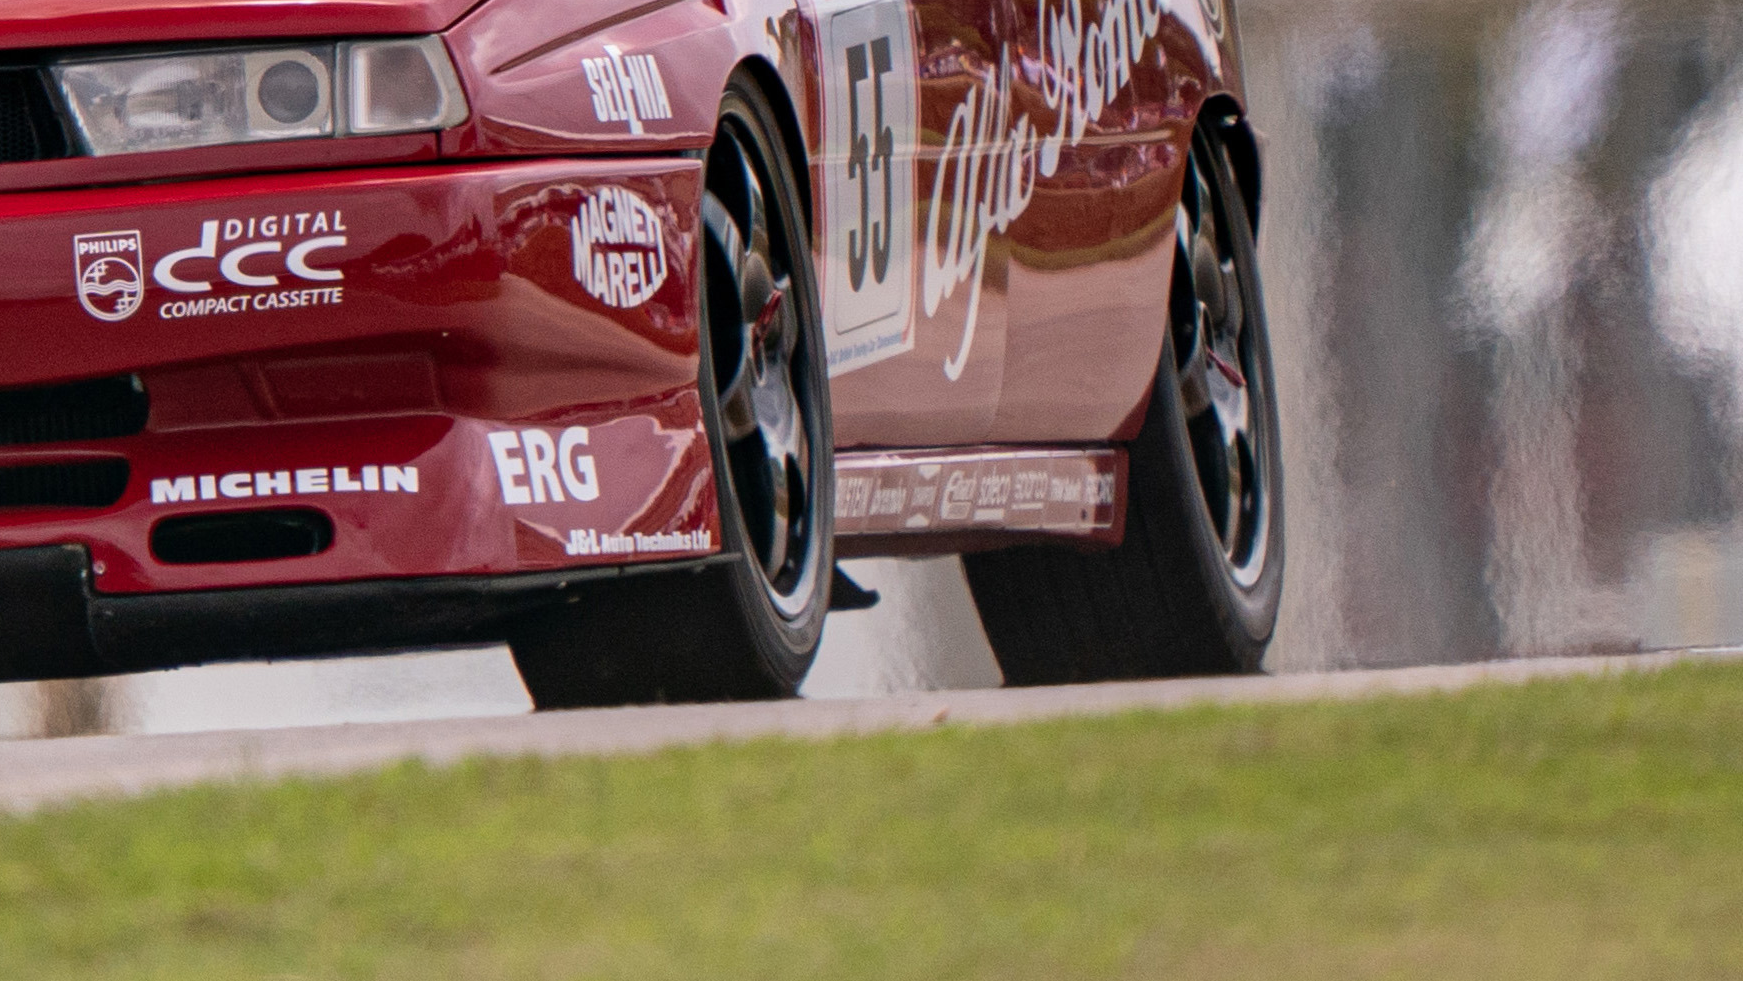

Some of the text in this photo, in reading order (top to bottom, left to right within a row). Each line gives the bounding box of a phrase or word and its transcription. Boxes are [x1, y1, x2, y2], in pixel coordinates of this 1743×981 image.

[582, 44, 673, 136] SELENIA
[846, 36, 893, 294] 55
[78, 235, 138, 255] PHILIPS
[224, 211, 348, 241] DIGITAL
[159, 286, 344, 319] COMPACT CASSETTE
[150, 465, 419, 504] MICHELIN
[488, 426, 600, 506] ERG
